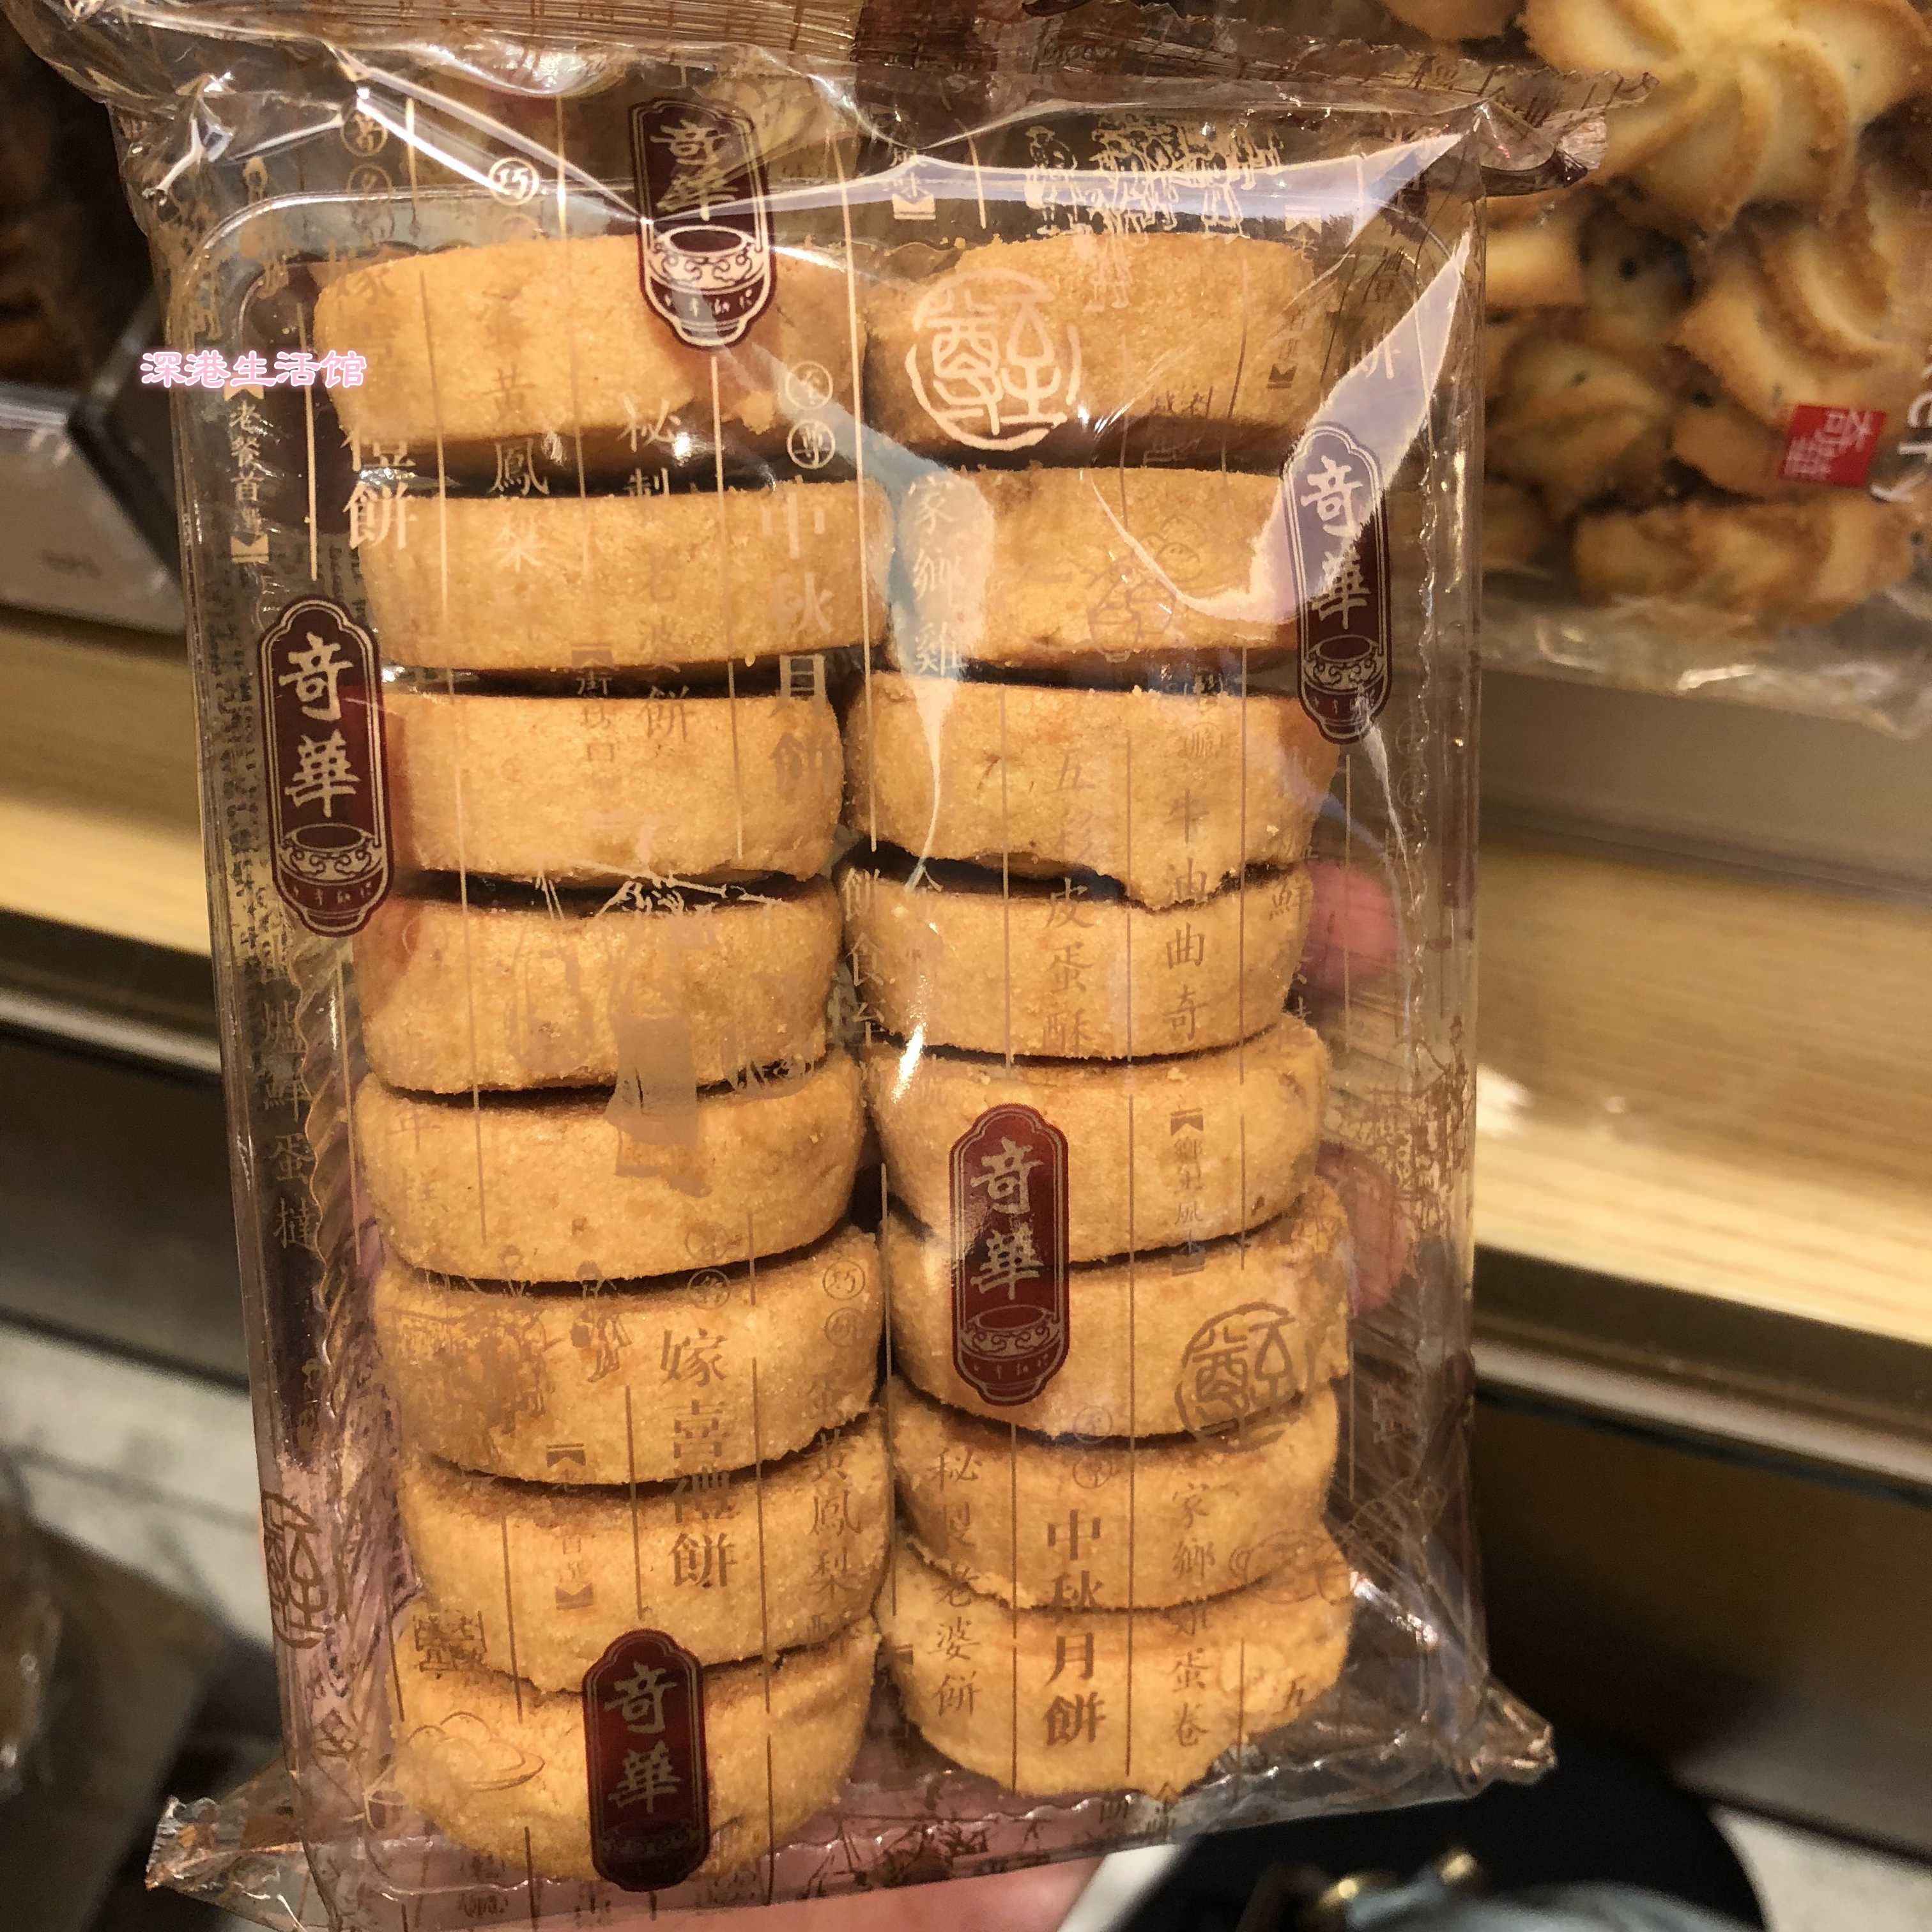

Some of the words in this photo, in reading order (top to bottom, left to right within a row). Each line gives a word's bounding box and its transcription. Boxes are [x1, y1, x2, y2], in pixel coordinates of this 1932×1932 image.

[1301, 454, 1372, 630] 奇華
[279, 631, 363, 819] 奇華
[969, 1136, 1045, 1301] 奇華
[1043, 1508, 1108, 1748] 中秋月餅
[603, 1661, 682, 1816] 奇華
